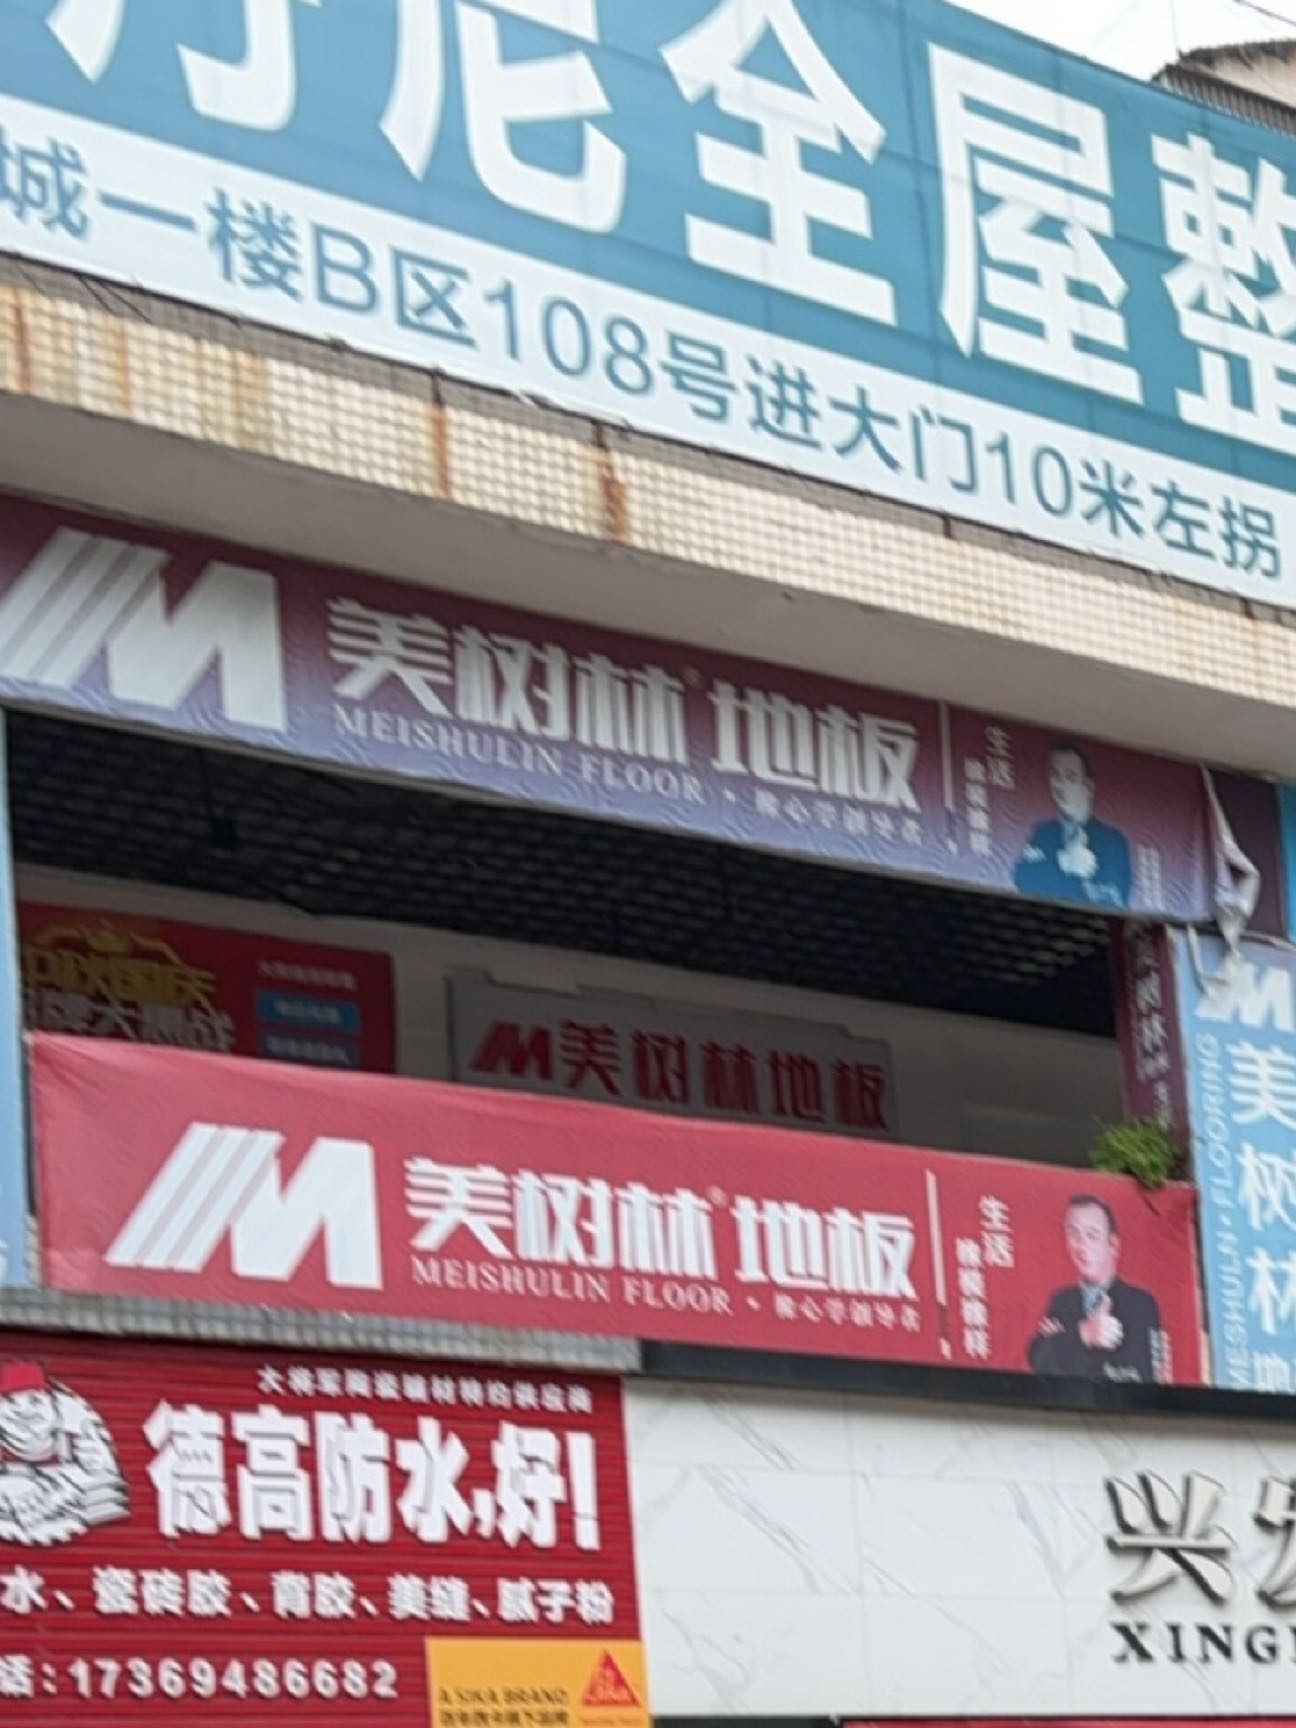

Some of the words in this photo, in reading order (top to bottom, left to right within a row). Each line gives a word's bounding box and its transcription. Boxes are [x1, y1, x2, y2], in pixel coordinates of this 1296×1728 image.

[579, 757, 705, 808] FLOOR
[558, 1018, 888, 1132] 美树林地板
[410, 1254, 610, 1303] MEISHULIN
[624, 1276, 734, 1318] FLOOR
